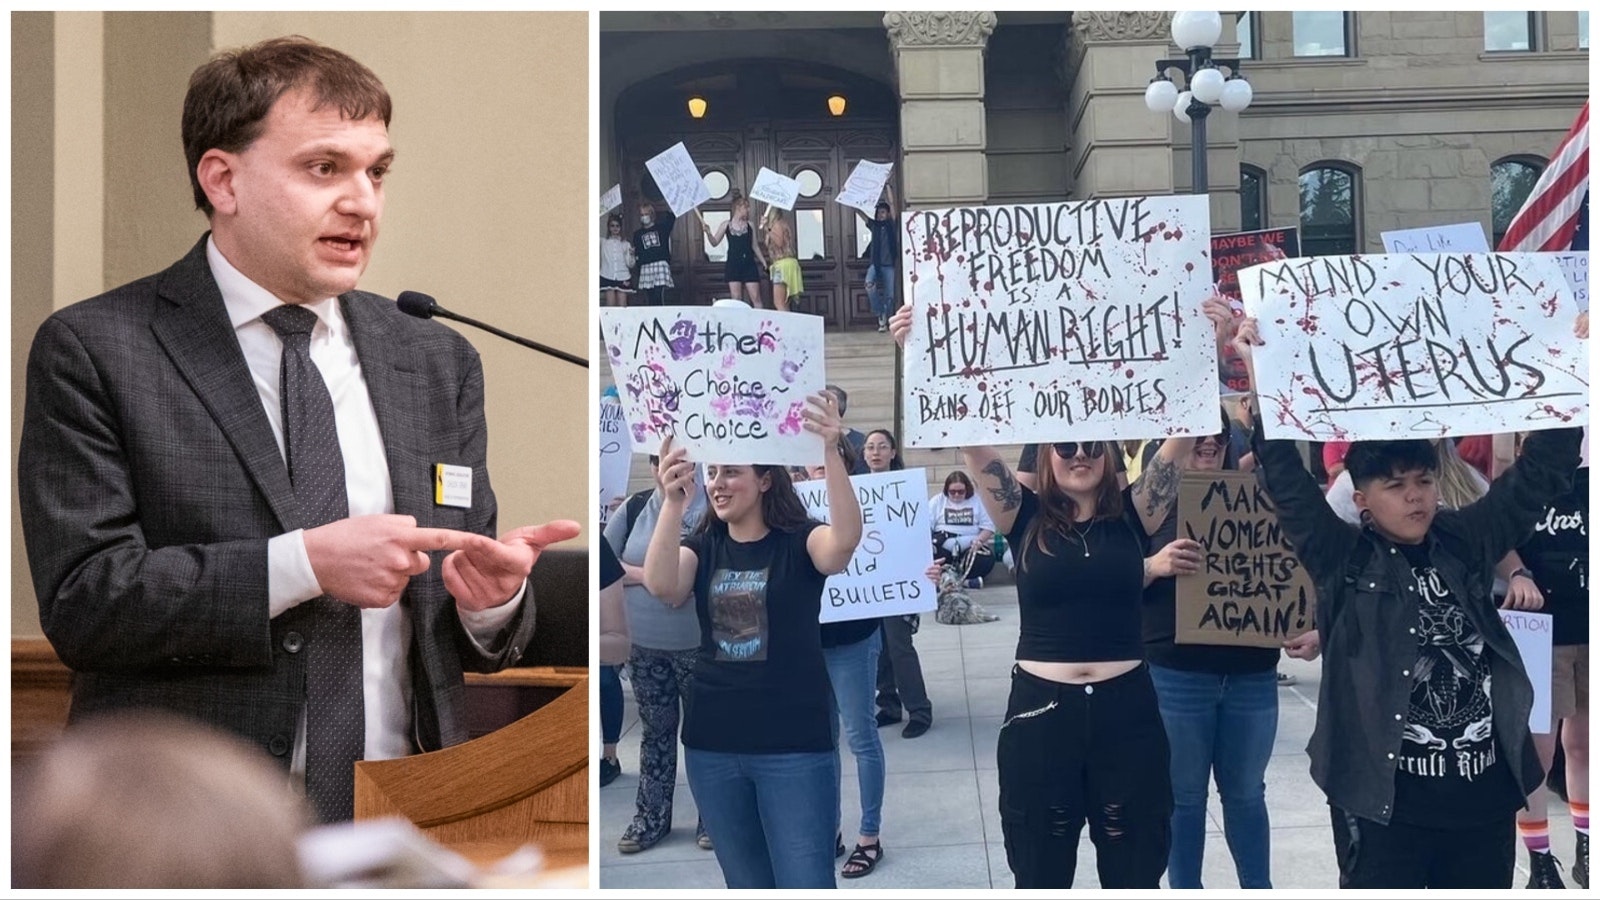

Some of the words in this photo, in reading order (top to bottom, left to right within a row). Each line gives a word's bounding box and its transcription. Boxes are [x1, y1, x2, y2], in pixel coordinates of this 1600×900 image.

[925, 196, 1151, 254] REPRODUCTIVE
[1260, 232, 1285, 243] WE
[967, 246, 1111, 292] FREEDOM
[1260, 256, 1377, 300] MIND
[1411, 254, 1537, 297] YOUR
[1008, 284, 1032, 306] IS
[1056, 283, 1072, 301] A
[1344, 297, 1451, 337] OWN
[926, 309, 1051, 377] HUMAN
[1059, 291, 1181, 369] RIGHT!
[1308, 334, 1545, 403] UTERUS
[638, 365, 682, 411] By
[684, 369, 766, 398] Choice
[919, 393, 967, 424] BANS
[979, 388, 1015, 421] OFF
[1034, 390, 1073, 425] OUR
[1083, 379, 1166, 419] BODIES
[684, 413, 768, 439] Choice
[801, 480, 906, 509] WODN'T
[1201, 480, 1277, 513] MAK
[887, 501, 919, 528] MY
[1206, 553, 1299, 583] RIGHTS
[829, 580, 920, 607] BULLETS
[1207, 580, 1291, 602] GREAT
[1199, 585, 1307, 638] AGAIN!
[1503, 614, 1549, 632] RTION
